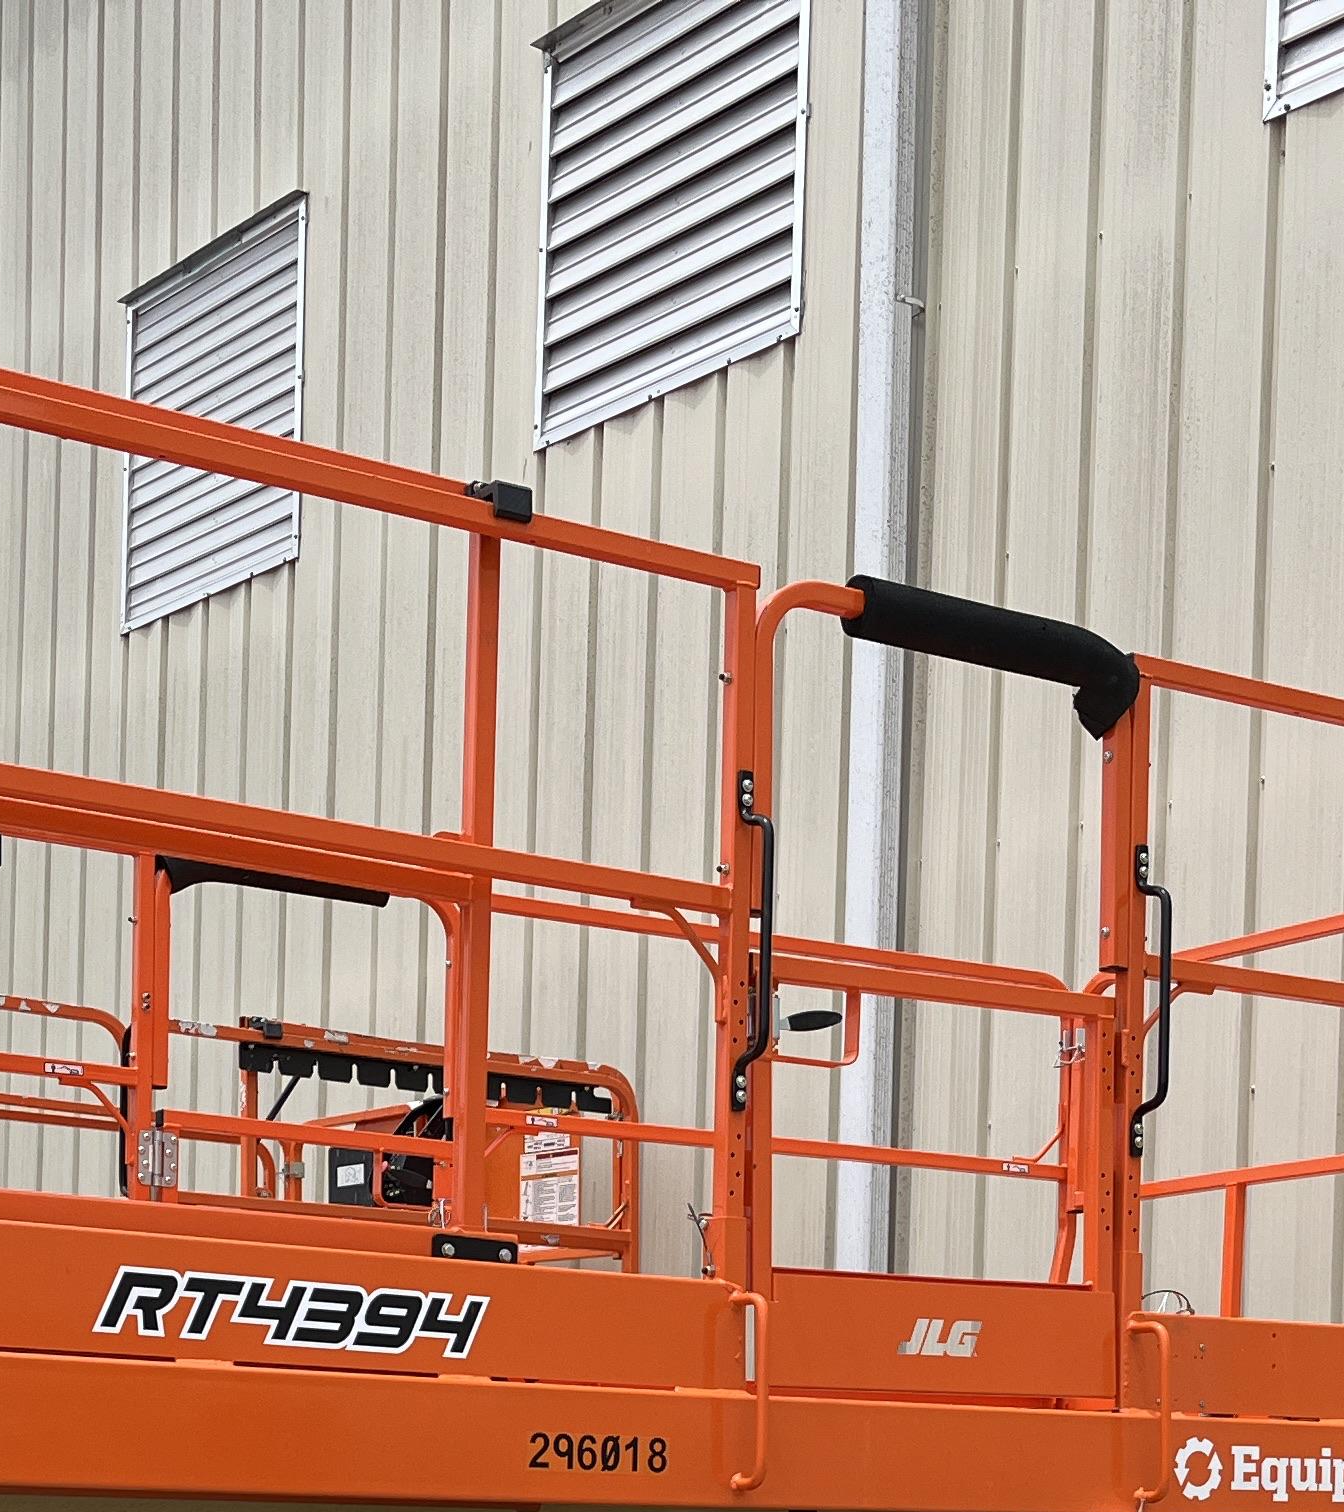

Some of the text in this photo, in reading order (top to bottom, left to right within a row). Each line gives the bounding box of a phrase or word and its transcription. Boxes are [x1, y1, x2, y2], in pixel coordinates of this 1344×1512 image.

[92, 1265, 490, 1359] RT4394
[897, 1318, 982, 1357] JLG
[529, 1432, 667, 1473] 296018
